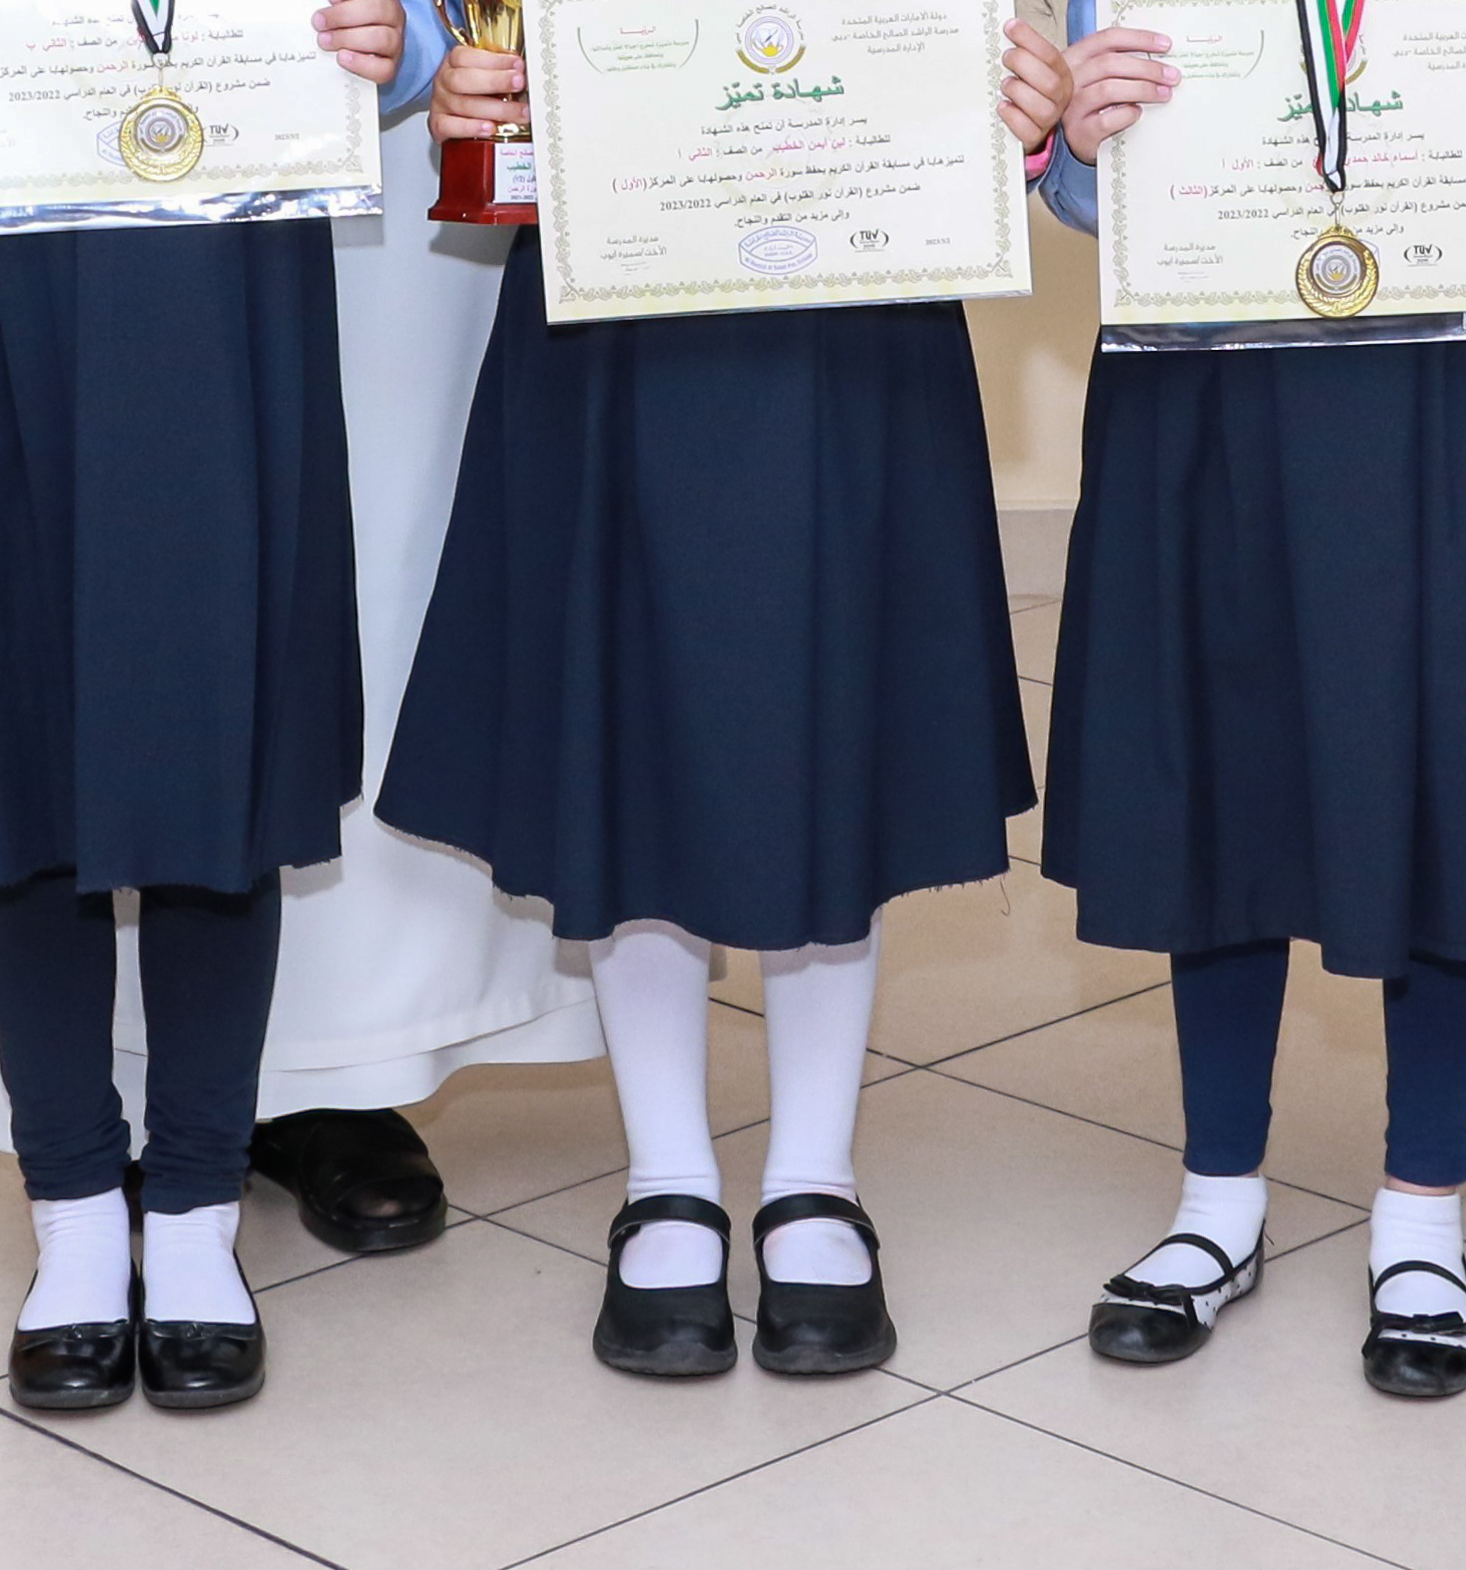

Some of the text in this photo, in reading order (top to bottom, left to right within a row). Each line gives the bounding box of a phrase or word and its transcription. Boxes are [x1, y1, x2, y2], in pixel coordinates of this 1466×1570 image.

[77, 37, 103, 47] الصف
[180, 56, 205, 71] الكريم
[264, 52, 277, 66] في
[96, 59, 130, 74] الرحمن
[215, 79, 246, 94] مشروع
[8, 88, 61, 102] 2023/2022
[1346, 90, 1404, 118] شهاد
[787, 117, 823, 130] المدرسة
[701, 124, 733, 137] الشهادة
[1262, 135, 1294, 148] الشهادة
[1296, 134, 1311, 144] هذه
[722, 145, 748, 156] الصف
[749, 145, 763, 156] من
[912, 156, 926, 171] في
[1263, 158, 1288, 168] الصف
[1291, 159, 1304, 169] من
[744, 166, 779, 184] الرحمن
[779, 167, 804, 179] سورة
[804, 165, 827, 175] بحفظ
[828, 163, 853, 177] الكريم
[648, 174, 677, 190] المركز
[1363, 179, 1385, 189] بحفظ
[1386, 177, 1410, 191] الكريم
[818, 188, 832, 201] نور
[865, 184, 896, 199] مشروع
[1208, 184, 1237, 197] المركز
[659, 197, 712, 212] 2023/2022
[769, 191, 782, 206] في
[1374, 202, 1388, 215] نور
[1420, 199, 1451, 214] مشروع
[794, 213, 808, 224] من
[810, 211, 829, 222] مزيد
[1217, 208, 1270, 220] 2023/2022
[1365, 224, 1384, 236] مزيد
